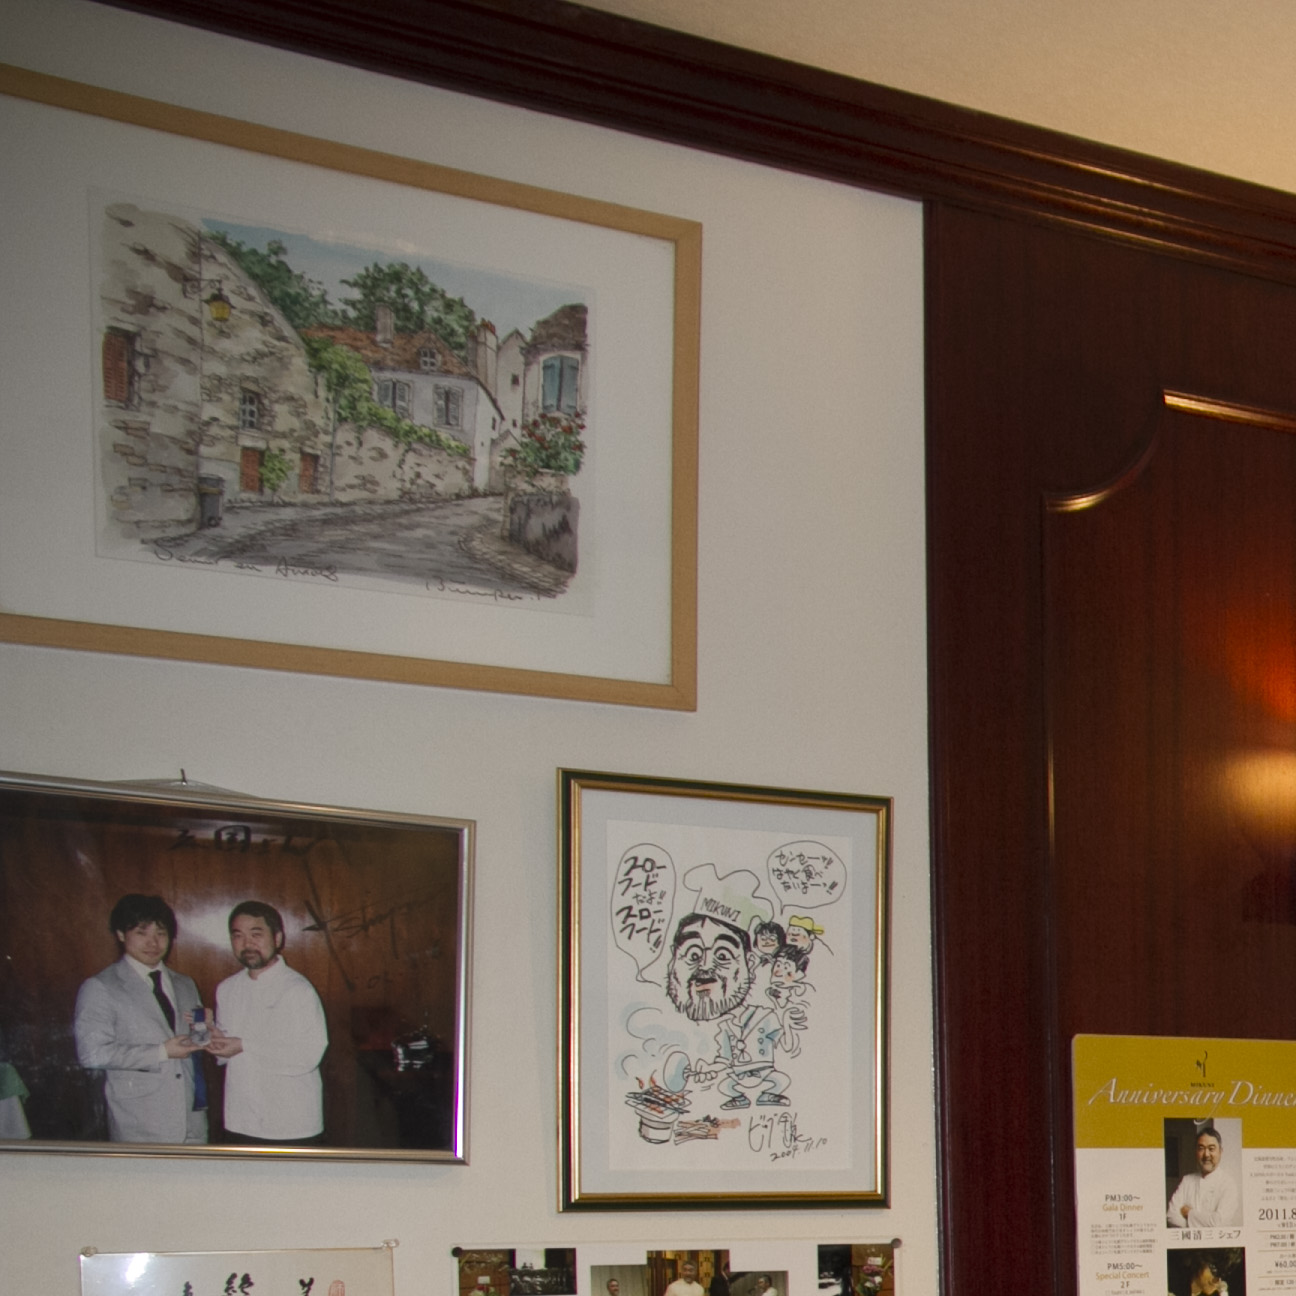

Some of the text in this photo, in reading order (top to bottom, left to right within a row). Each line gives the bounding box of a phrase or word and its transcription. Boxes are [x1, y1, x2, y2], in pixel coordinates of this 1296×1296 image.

[701, 898, 741, 922] MIKUNI
[1088, 1076, 1225, 1125] Anniversary
[1102, 1204, 1144, 1212] Gala Dinner
[1170, 1229, 1242, 1241] 三國清三 シェフ
[1095, 1271, 1150, 1281] Special Concert
